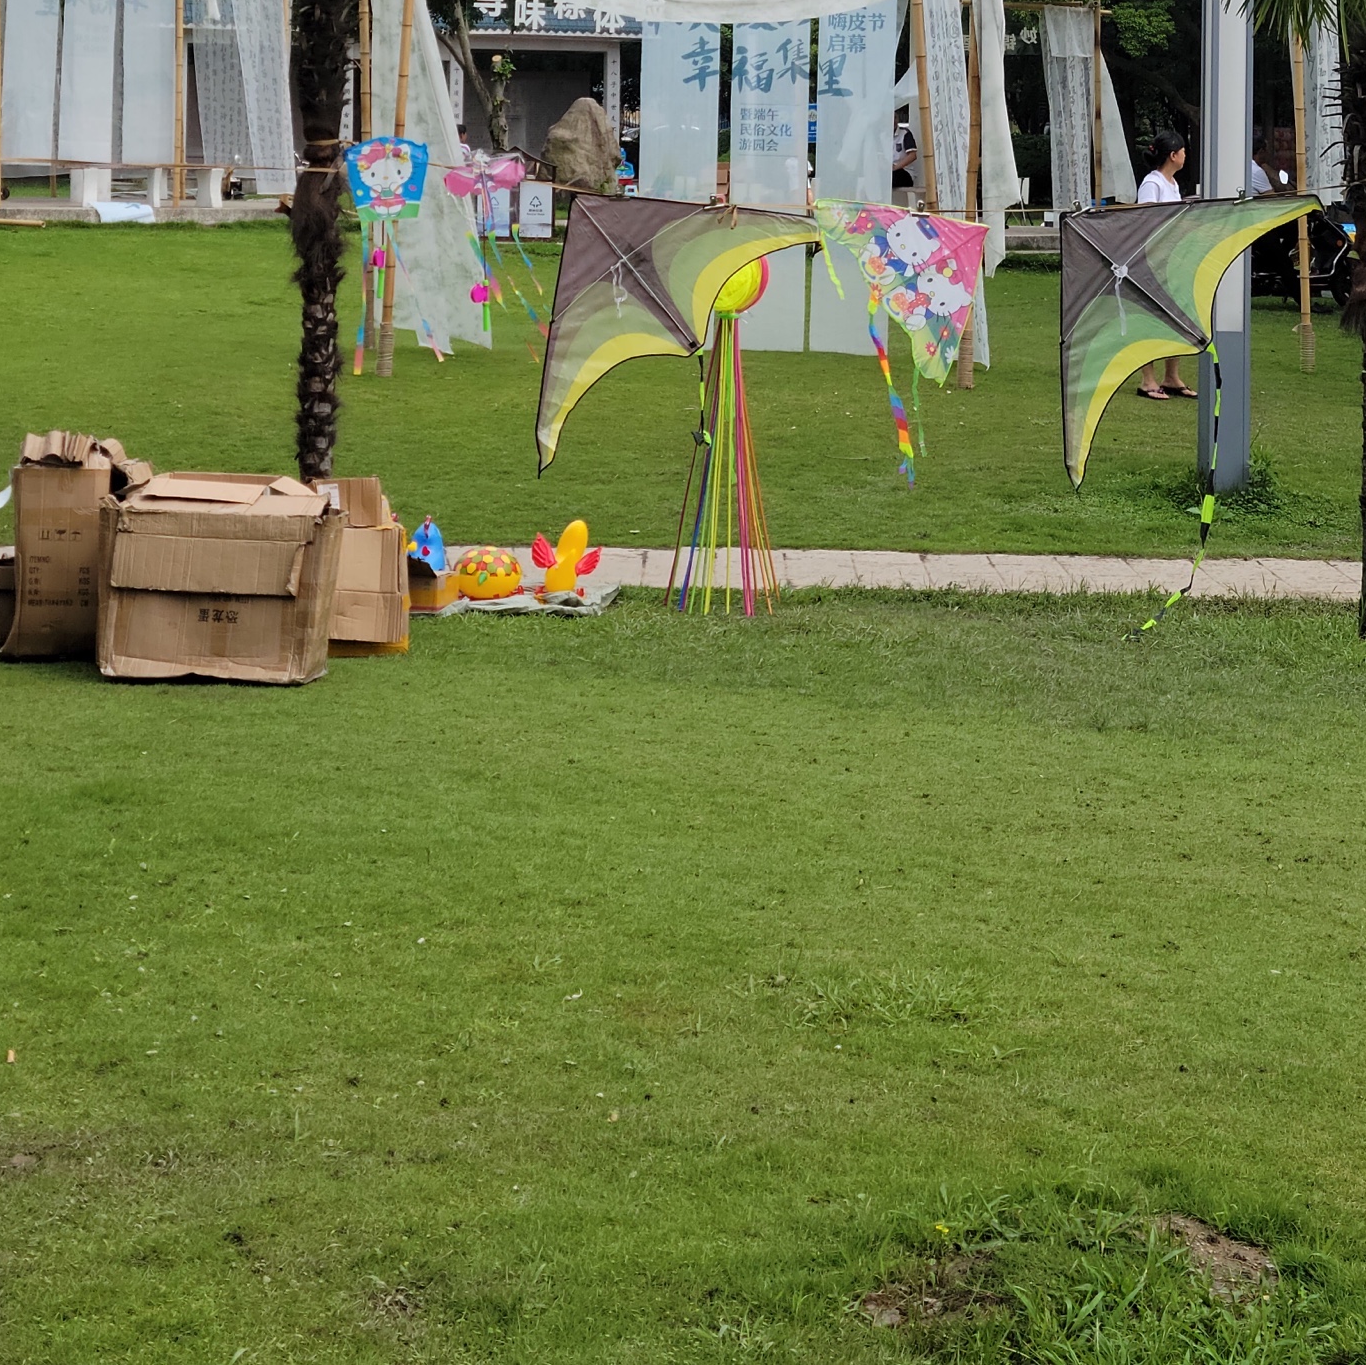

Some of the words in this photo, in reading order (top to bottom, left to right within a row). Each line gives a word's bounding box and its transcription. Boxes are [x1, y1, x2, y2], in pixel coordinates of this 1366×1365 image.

[827, 12, 887, 33] 嗨皮节
[826, 33, 867, 54] 启幕
[681, 36, 854, 98] 幸福集里
[739, 107, 780, 123] 暨端午
[739, 123, 793, 138] 民俗文化
[738, 137, 779, 152] 游园会
